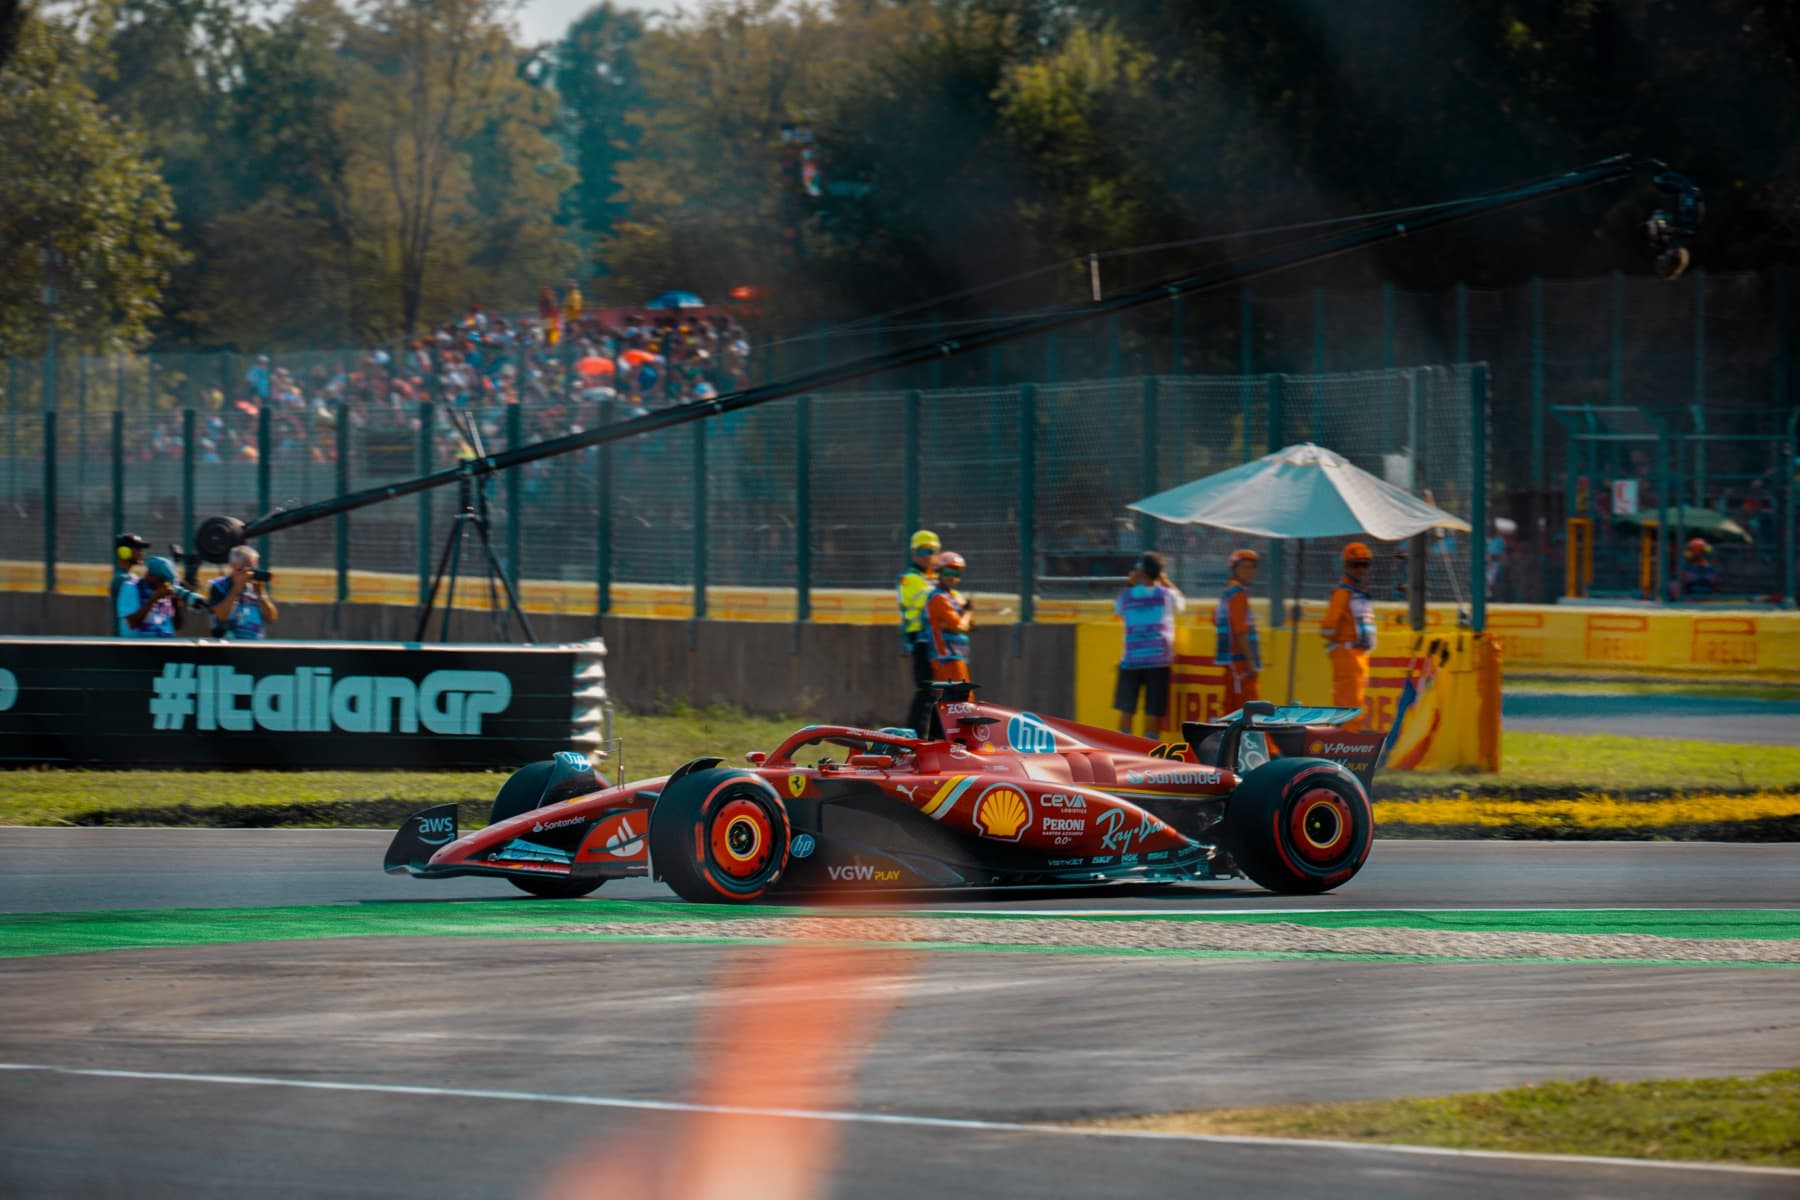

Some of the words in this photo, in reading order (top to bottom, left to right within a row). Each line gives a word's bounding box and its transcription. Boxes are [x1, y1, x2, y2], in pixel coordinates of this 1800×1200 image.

[150, 661, 513, 736] #ItalianGP
[1324, 742, 1375, 753] V-Power
[1146, 769, 1222, 785] Santander
[418, 816, 453, 833] aws
[543, 815, 586, 831] Santander
[1042, 817, 1086, 831] PERONI
[794, 834, 812, 857] hp
[827, 865, 875, 881] VGW
[874, 871, 900, 881] PLAY
